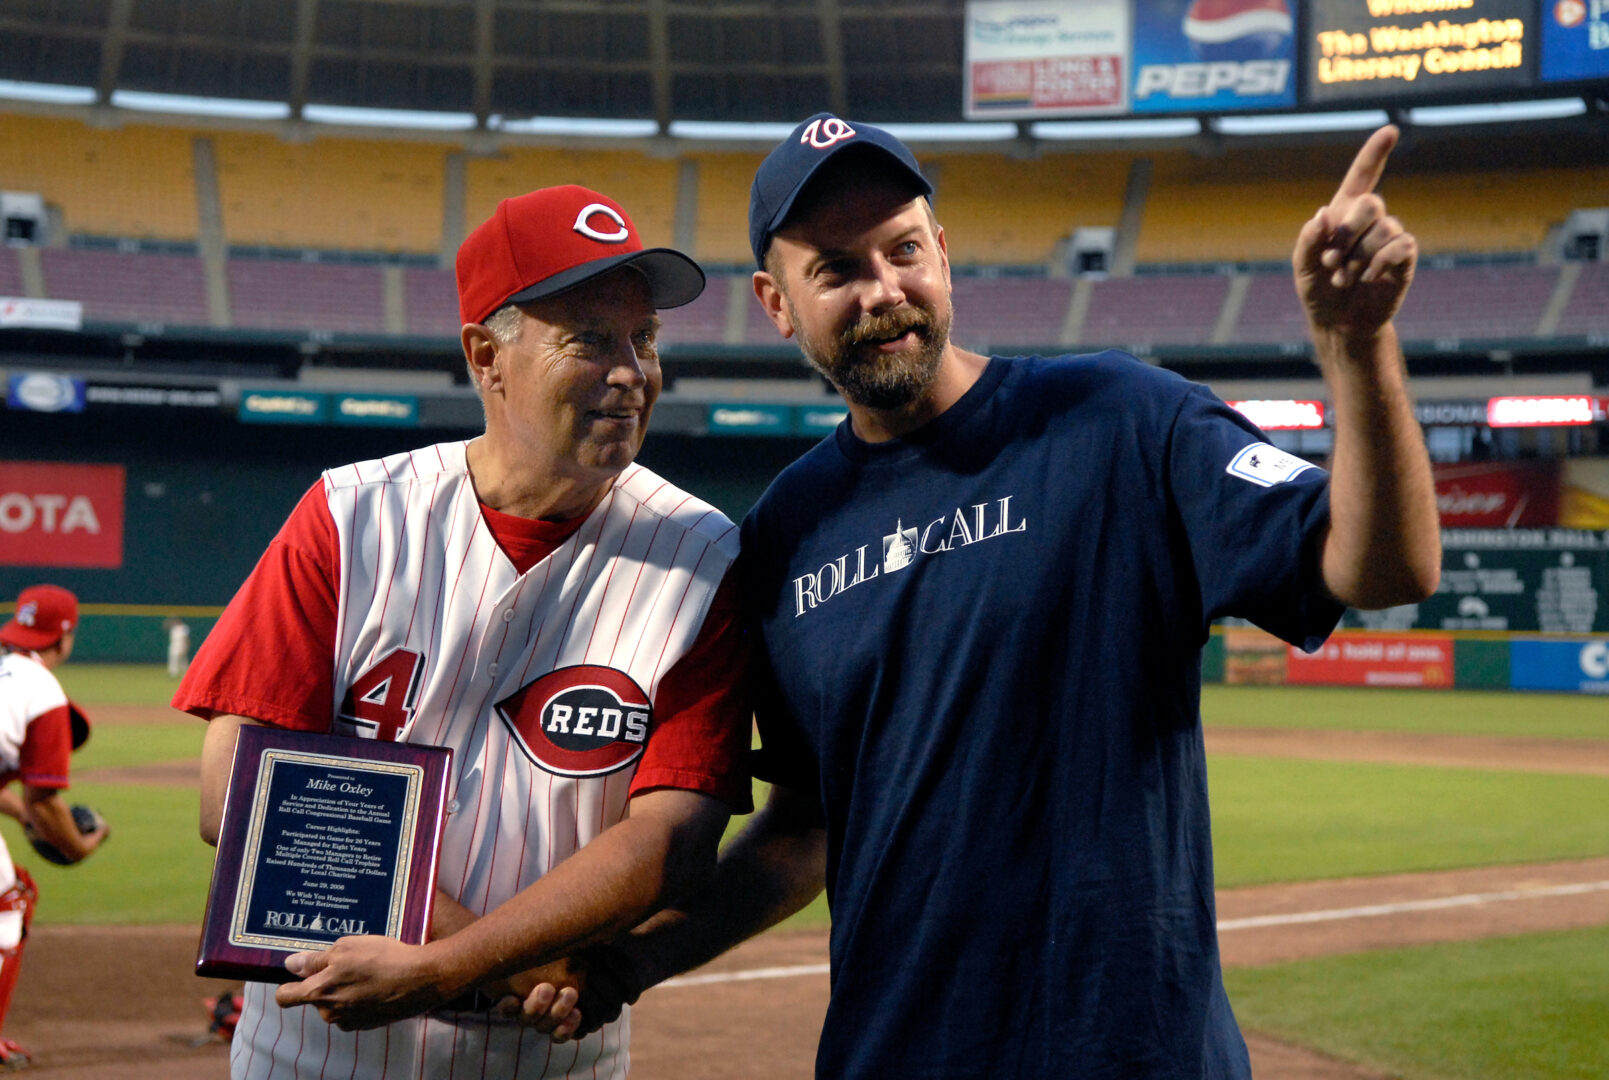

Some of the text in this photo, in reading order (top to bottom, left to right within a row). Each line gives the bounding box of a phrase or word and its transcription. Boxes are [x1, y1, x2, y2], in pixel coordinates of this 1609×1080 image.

[1317, 18, 1523, 56] The Washington
[1423, 40, 1522, 74] Council
[1136, 59, 1291, 99] PEPSI
[801, 117, 856, 149] W
[572, 203, 629, 244] C
[793, 495, 1027, 618] ROLL CALL
[546, 703, 649, 742] REDS
[306, 778, 373, 797] Mike Oxley
[298, 796, 336, 804] Appreciation
[305, 809, 347, 819] Congressional
[348, 814, 373, 822] Baseball
[317, 804, 348, 813] Dedication
[282, 830, 318, 840] Participated
[293, 839, 321, 848] Managed
[332, 843, 348, 851] Eight
[275, 851, 301, 859] Multiple
[302, 854, 326, 862] Coveted
[354, 859, 380, 867] Trophies
[325, 850, 354, 858] Managers
[287, 860, 317, 869] Hundreds
[325, 864, 358, 873] Thousands
[328, 871, 356, 879] Charities
[316, 901, 349, 909] Retirement
[327, 894, 358, 903] Happiness
[264, 910, 309, 929] ROLL
[326, 917, 369, 934] CALL
